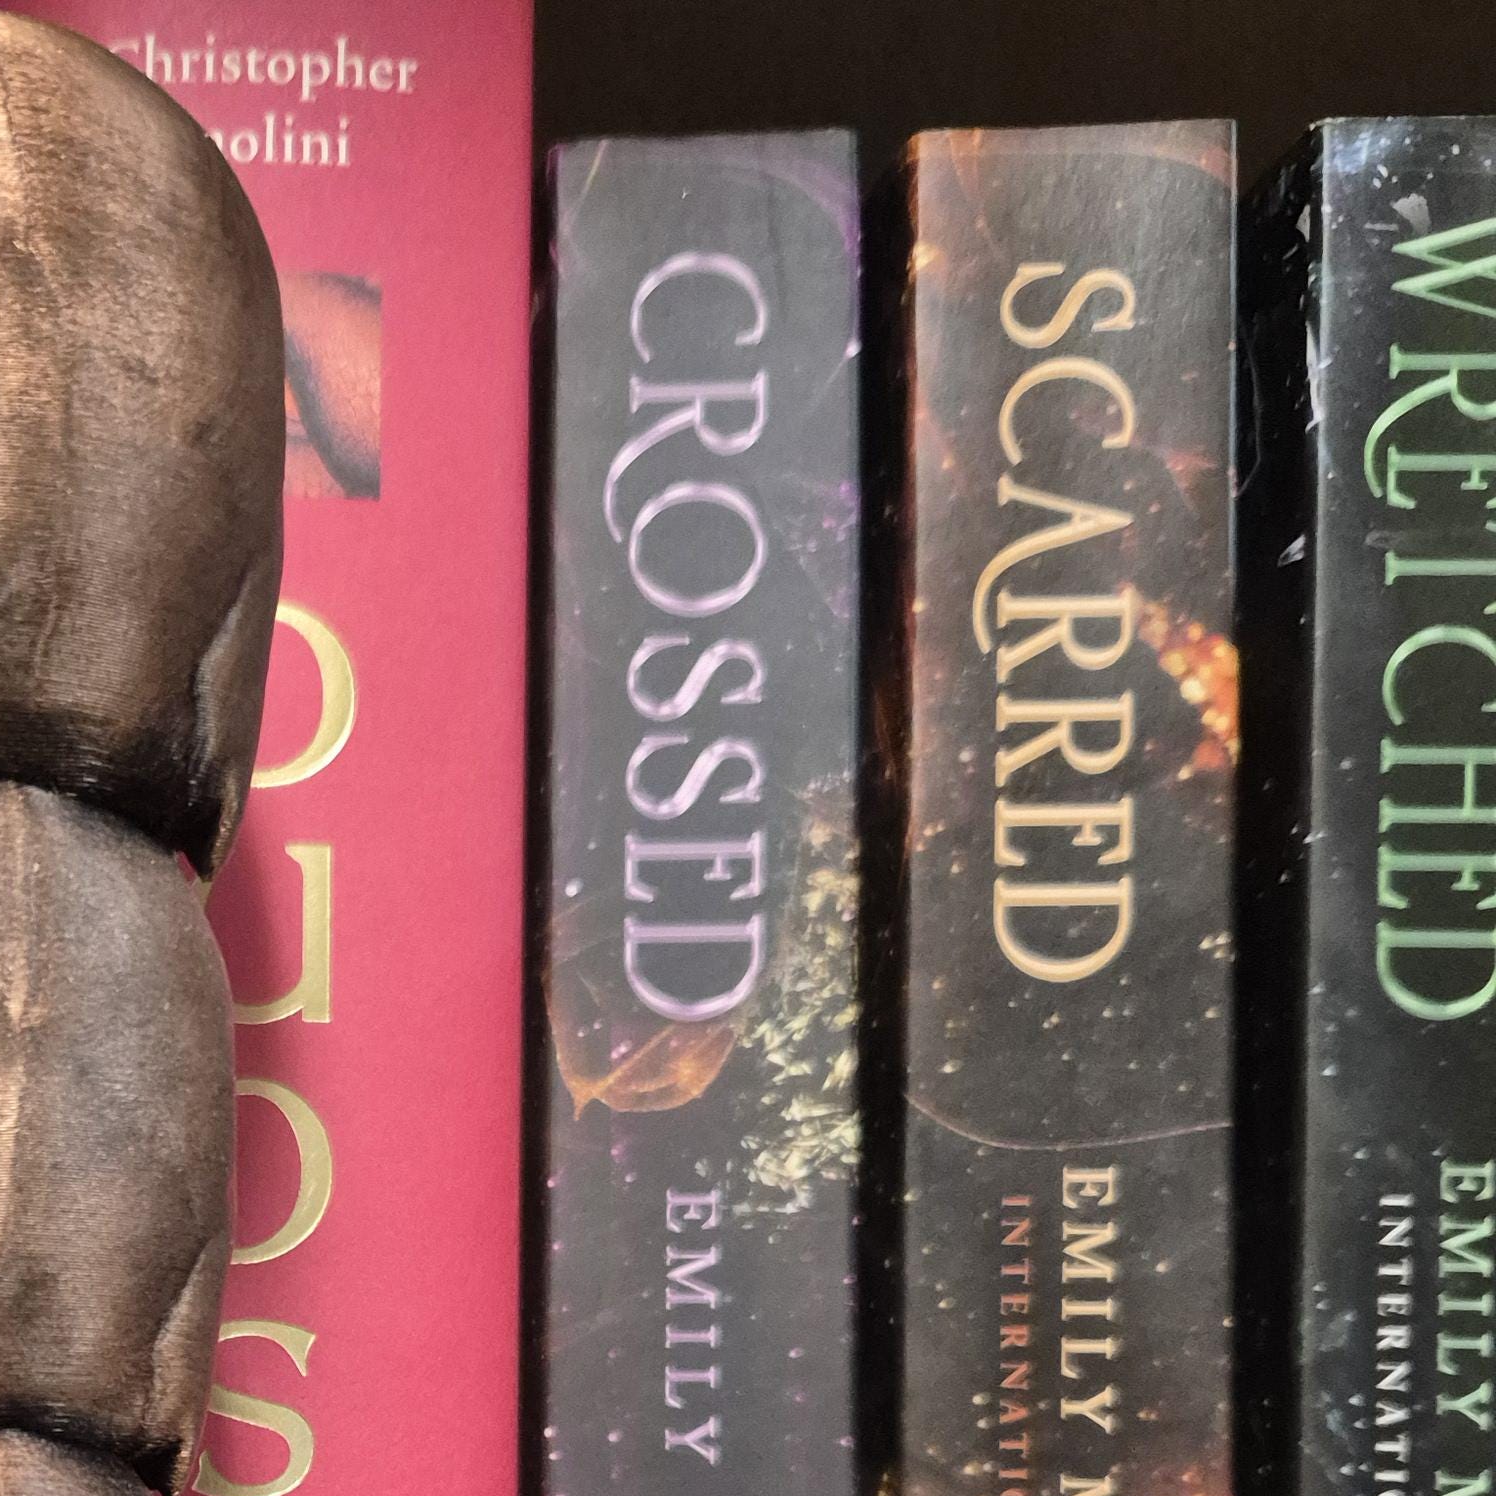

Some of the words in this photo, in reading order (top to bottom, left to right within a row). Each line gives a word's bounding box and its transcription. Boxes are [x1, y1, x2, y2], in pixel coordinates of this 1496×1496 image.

[108, 32, 418, 102] hristopher
[208, 112, 350, 167] olini
[603, 251, 768, 1022] CROSSED
[973, 262, 1136, 983] SCARRED
[1364, 217, 1496, 1020] WRETCHED
[663, 1188, 721, 1466] EMILY
[1059, 1164, 1116, 1435] EMILY
[1434, 1160, 1493, 1434] EMILY
